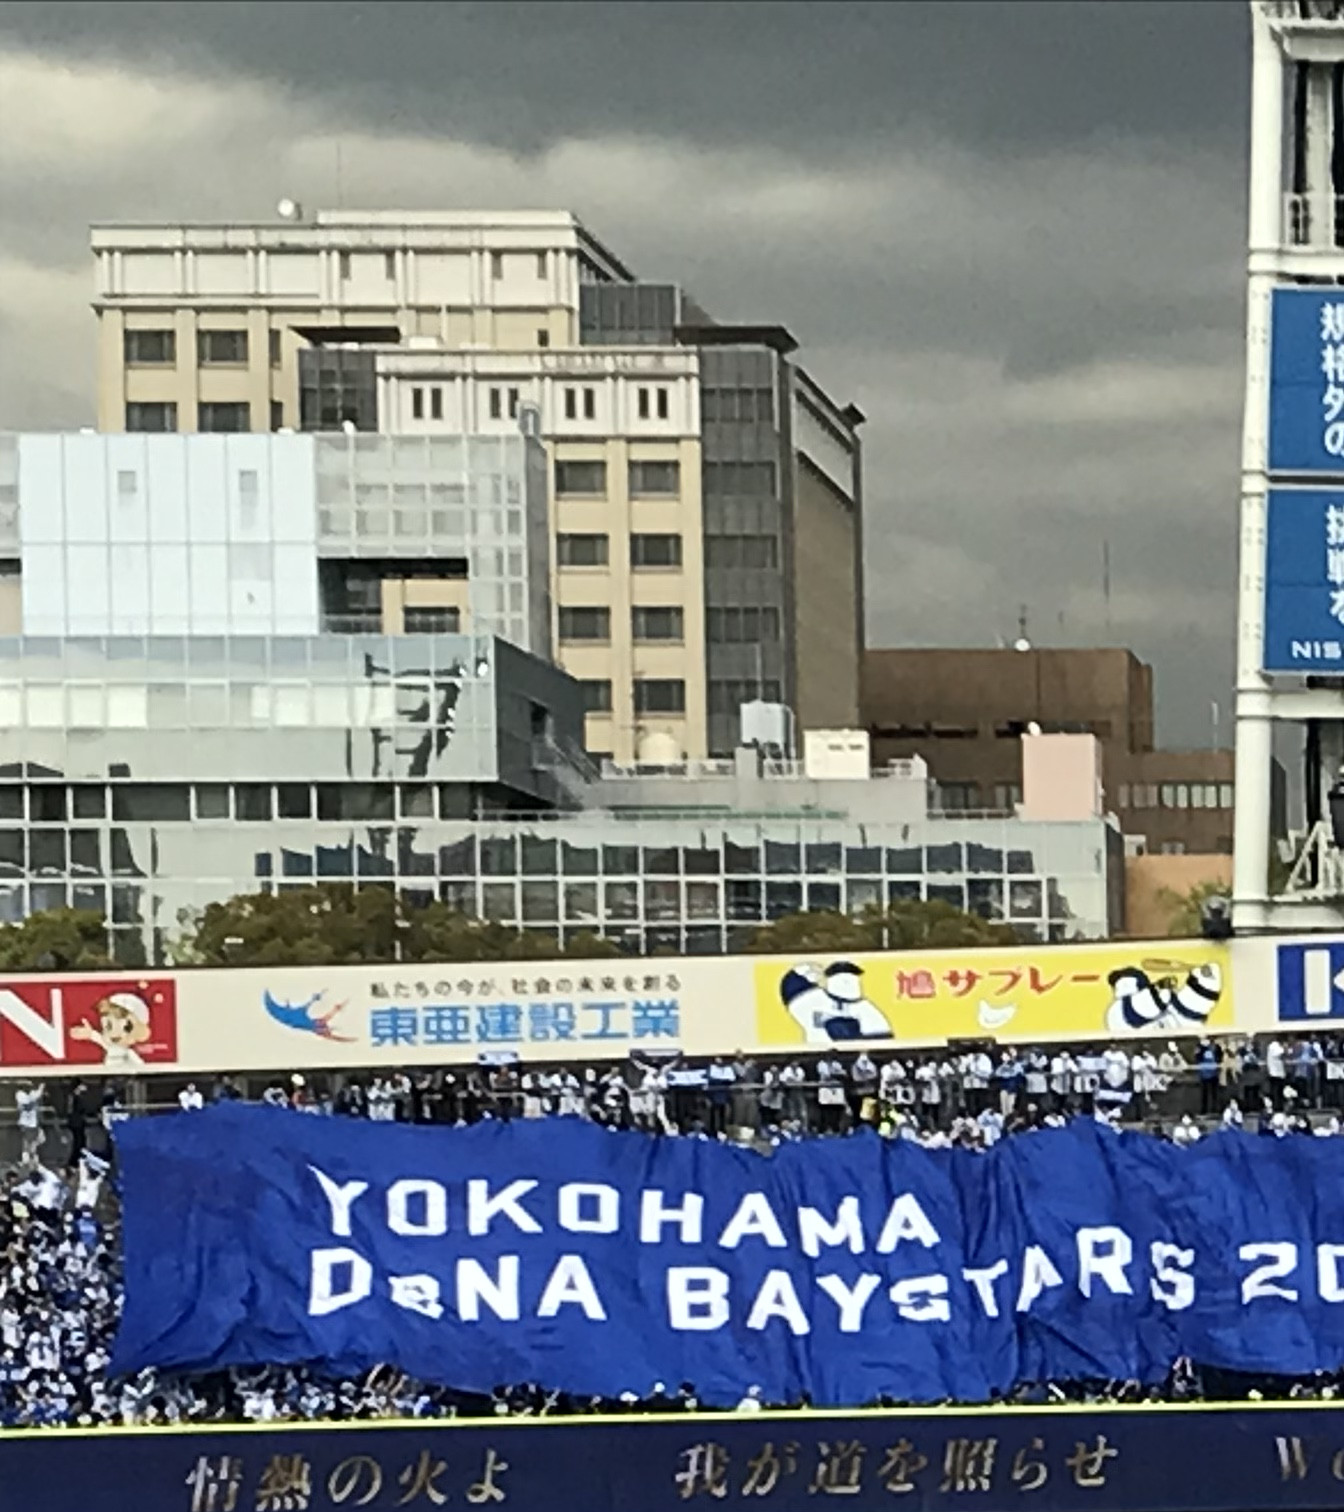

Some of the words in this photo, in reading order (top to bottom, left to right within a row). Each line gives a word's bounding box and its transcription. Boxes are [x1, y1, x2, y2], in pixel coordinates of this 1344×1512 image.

[896, 966, 1100, 999] 鳩サブレー
[370, 999, 680, 1047] 東亜建設工業
[307, 1164, 942, 1257] YOKOHAMA
[307, 1248, 607, 1321] DeNA
[666, 1225, 1196, 1336] BAYSTARS
[674, 1434, 1119, 1499] 我が道を照らせ
